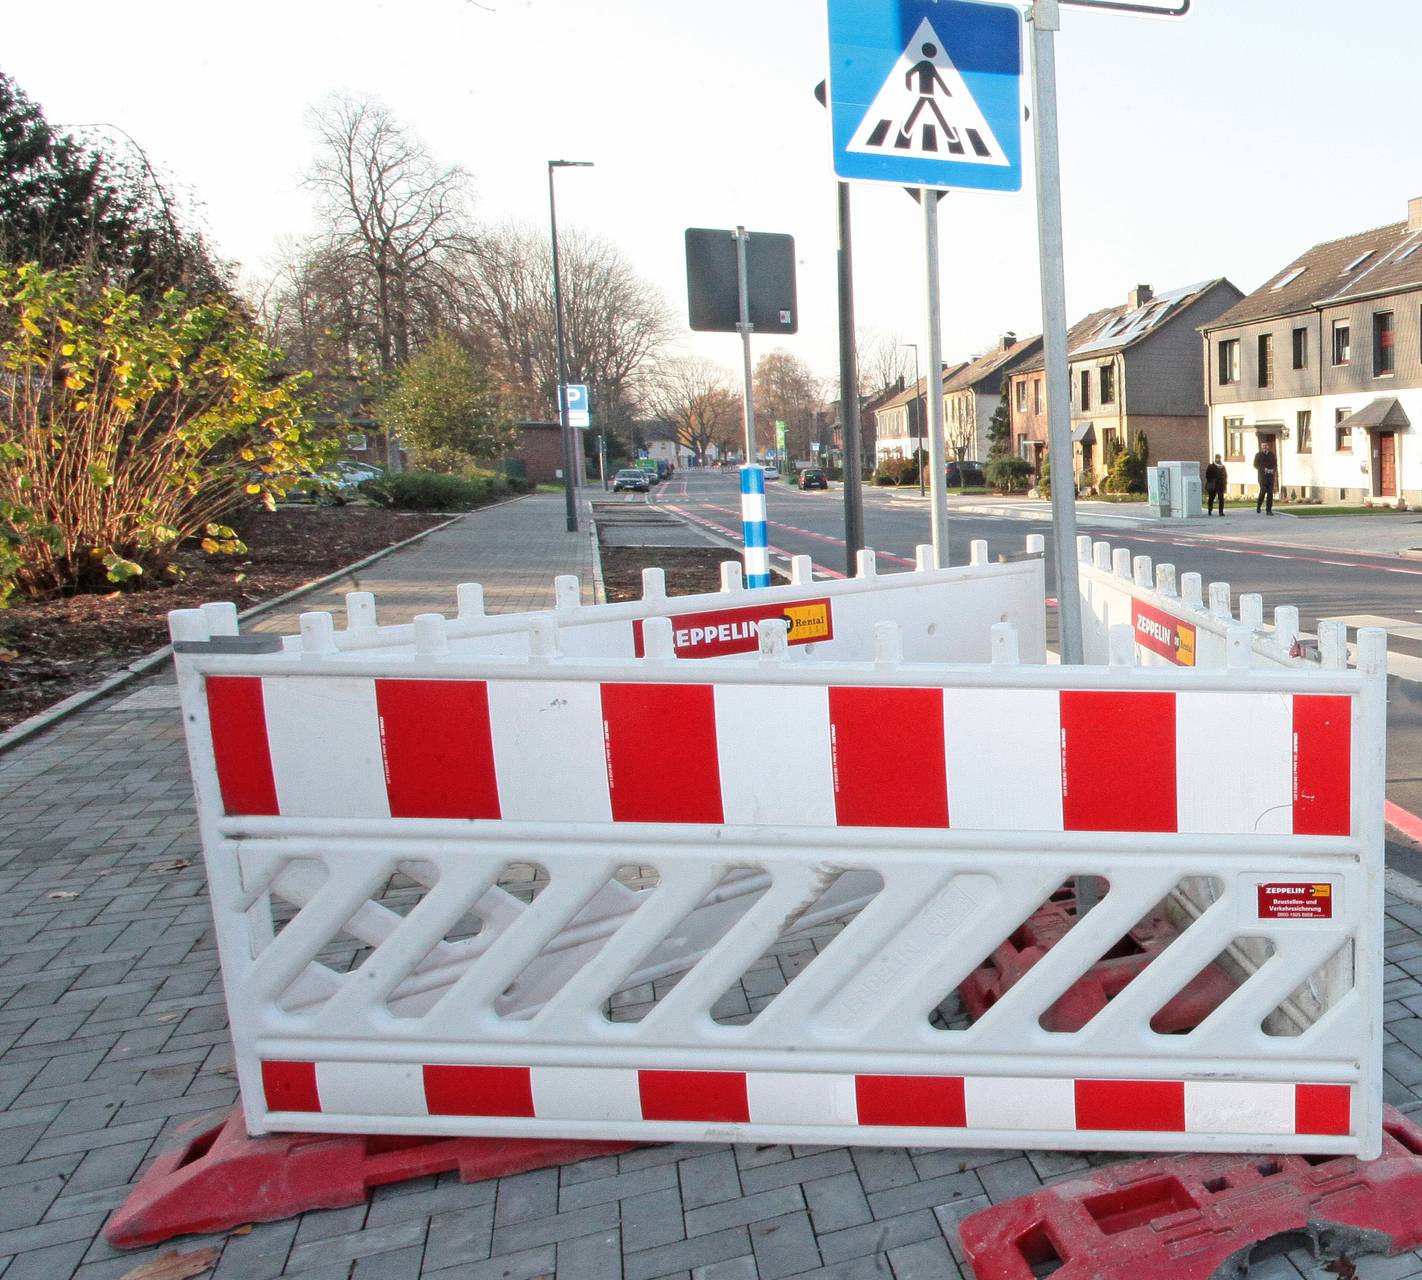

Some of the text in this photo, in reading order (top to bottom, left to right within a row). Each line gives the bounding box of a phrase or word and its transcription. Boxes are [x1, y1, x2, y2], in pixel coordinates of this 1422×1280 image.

[567, 389, 581, 408] P
[673, 621, 761, 648] EPPELIN
[795, 616, 825, 627] Rental
[1136, 614, 1171, 646] ZEPPELIN
